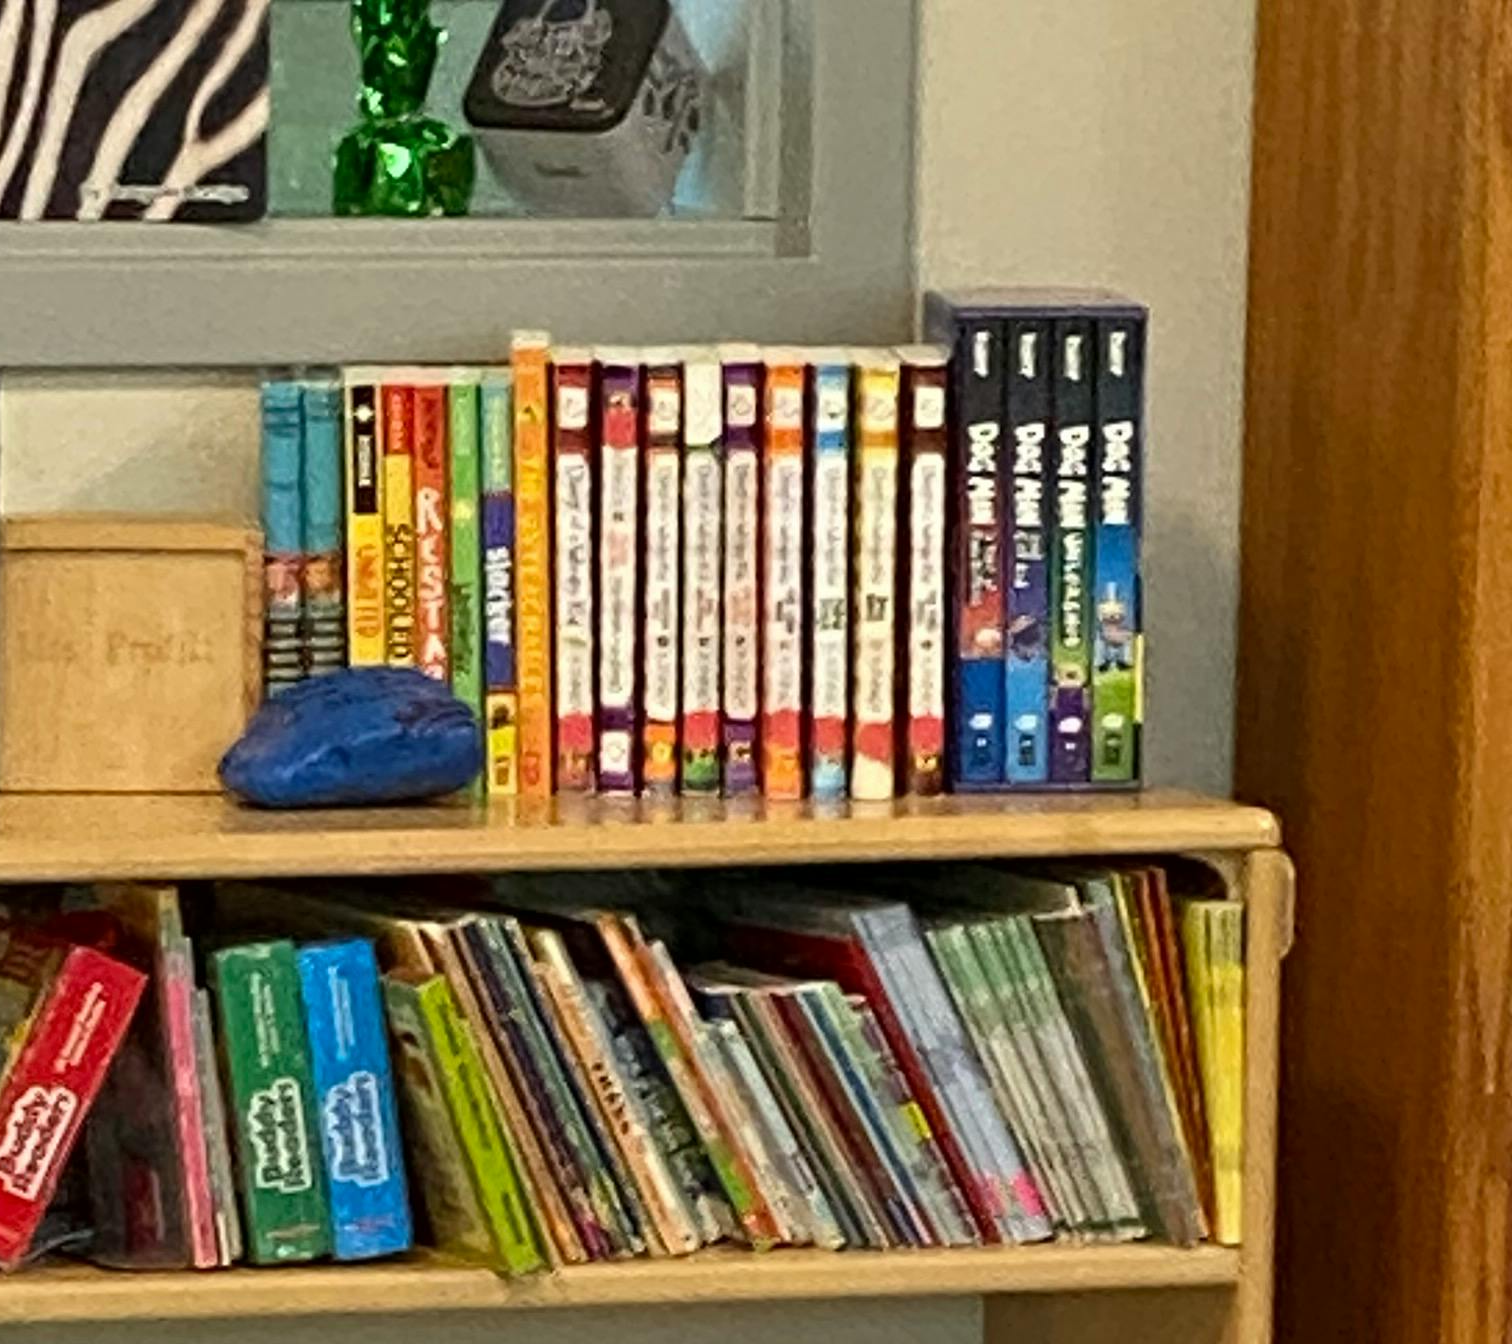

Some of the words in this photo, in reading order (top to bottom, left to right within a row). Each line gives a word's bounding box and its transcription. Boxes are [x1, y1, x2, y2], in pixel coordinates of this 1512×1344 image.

[967, 422, 1000, 473] DOG
[1013, 422, 1045, 475] DOG
[1057, 424, 1090, 477] DOG
[1101, 420, 1135, 473] DOG
[966, 475, 999, 525] MAN
[1012, 477, 1043, 527] MAN
[1056, 479, 1088, 528] MAN
[1100, 475, 1131, 525] MAN
[387, 523, 414, 659] SCHOOLED
[11, 1092, 70, 1197] Readers
[253, 1094, 285, 1183] Buddy
[276, 1082, 307, 1188] Readers
[331, 1086, 356, 1176] Buddy
[350, 1071, 383, 1181] Readers
